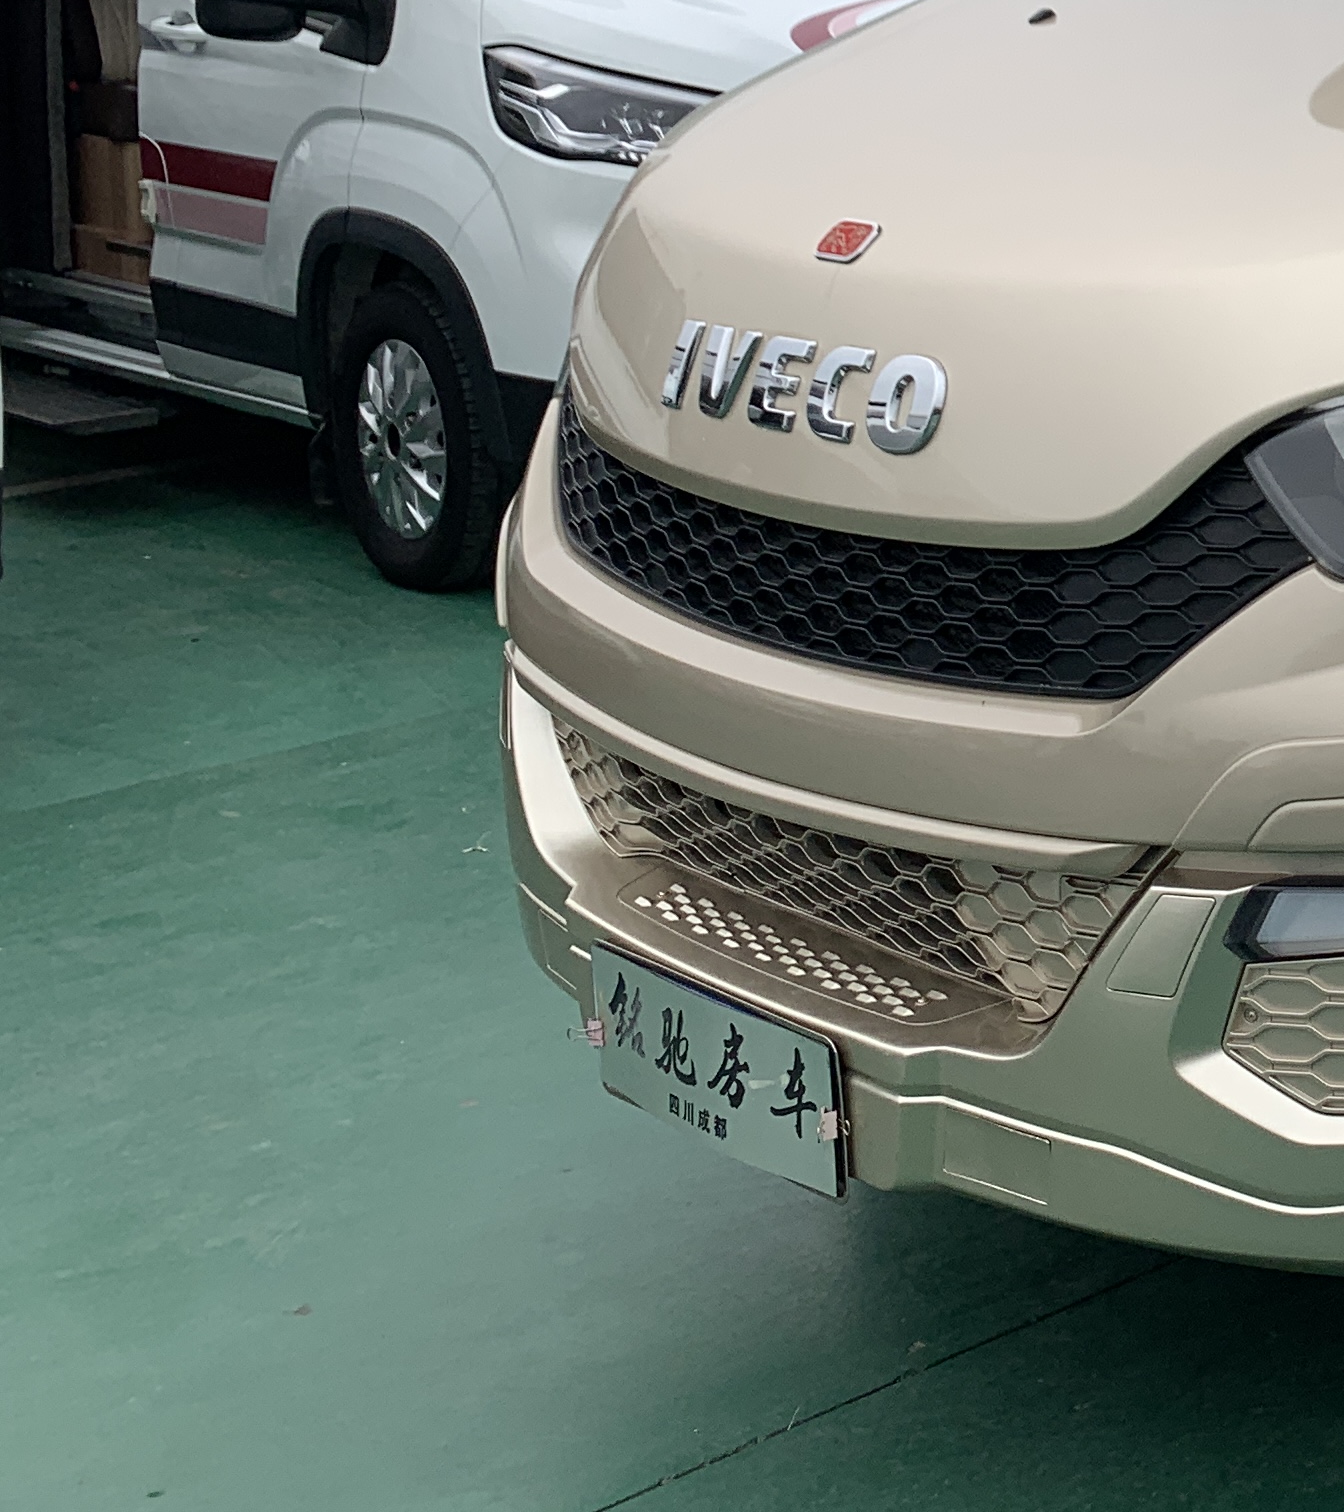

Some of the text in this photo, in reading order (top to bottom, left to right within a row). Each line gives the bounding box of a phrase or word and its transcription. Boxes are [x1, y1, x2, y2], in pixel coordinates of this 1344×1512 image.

[660, 318, 948, 456] IVECO
[669, 1093, 728, 1141] 四川成都
